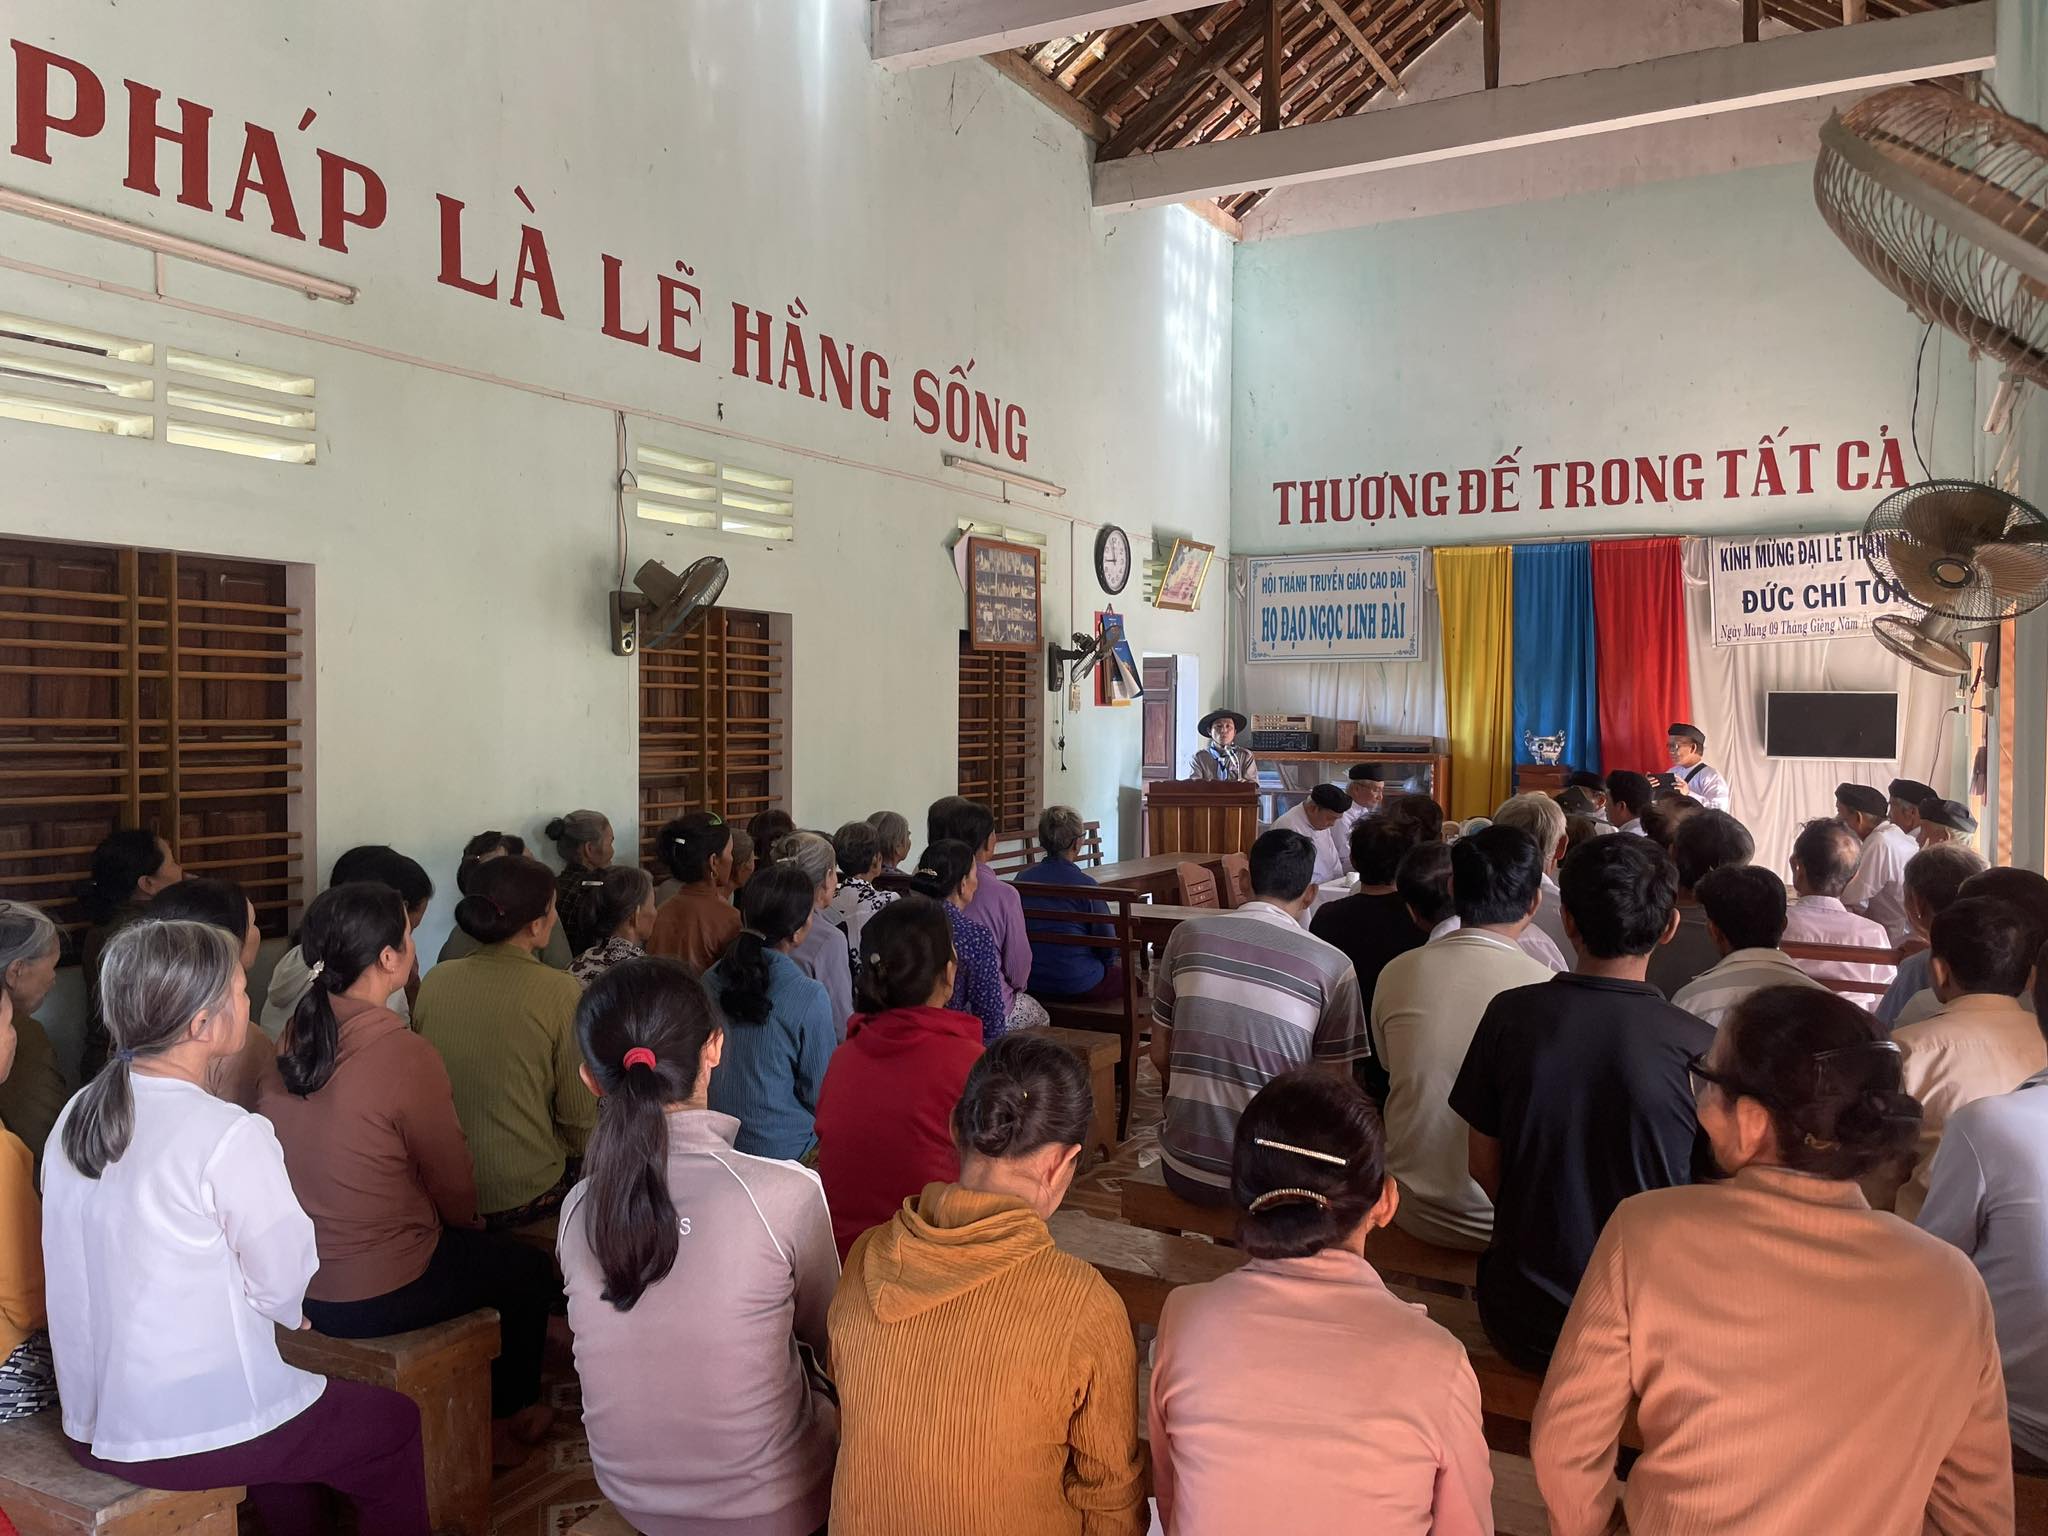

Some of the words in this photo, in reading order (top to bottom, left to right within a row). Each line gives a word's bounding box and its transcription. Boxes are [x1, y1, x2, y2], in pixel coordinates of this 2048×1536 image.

[11, 39, 387, 253] PHÁP
[436, 186, 564, 320] LÀ
[602, 253, 702, 363] LẼ
[732, 297, 890, 421] HẰNG
[913, 358, 1027, 462] SỐNG
[1273, 471, 1450, 527] THƯỢNG
[1458, 446, 1522, 514] ĐẾ
[1533, 453, 1704, 510] TRONG
[1716, 426, 1821, 499] TẤT
[1836, 425, 1910, 491] CẢ
[1720, 541, 1751, 572] KÍNH
[1756, 538, 1794, 569] MỪNG
[1798, 539, 1821, 569] ĐẠI
[1262, 572, 1276, 597] HỘI
[1279, 571, 1307, 593] THÁNH
[1347, 568, 1367, 590] GIÁO
[1370, 571, 1388, 589] CAO
[1390, 566, 1406, 589] ĐÀI
[1742, 581, 1794, 614] ĐỨC
[1803, 575, 1846, 609] CHÍ
[1262, 607, 1278, 650] HỌ
[1281, 605, 1306, 650] ĐẠO
[1309, 604, 1343, 649] NGỌC
[1347, 602, 1376, 640] LINH
[1381, 591, 1405, 639] ĐÀI
[1721, 624, 1741, 641] Ngày
[1769, 621, 1778, 635] 09
[1781, 619, 1808, 637] Tháng
[1810, 617, 1836, 635] Giêng
[1838, 615, 1858, 631] Năm
